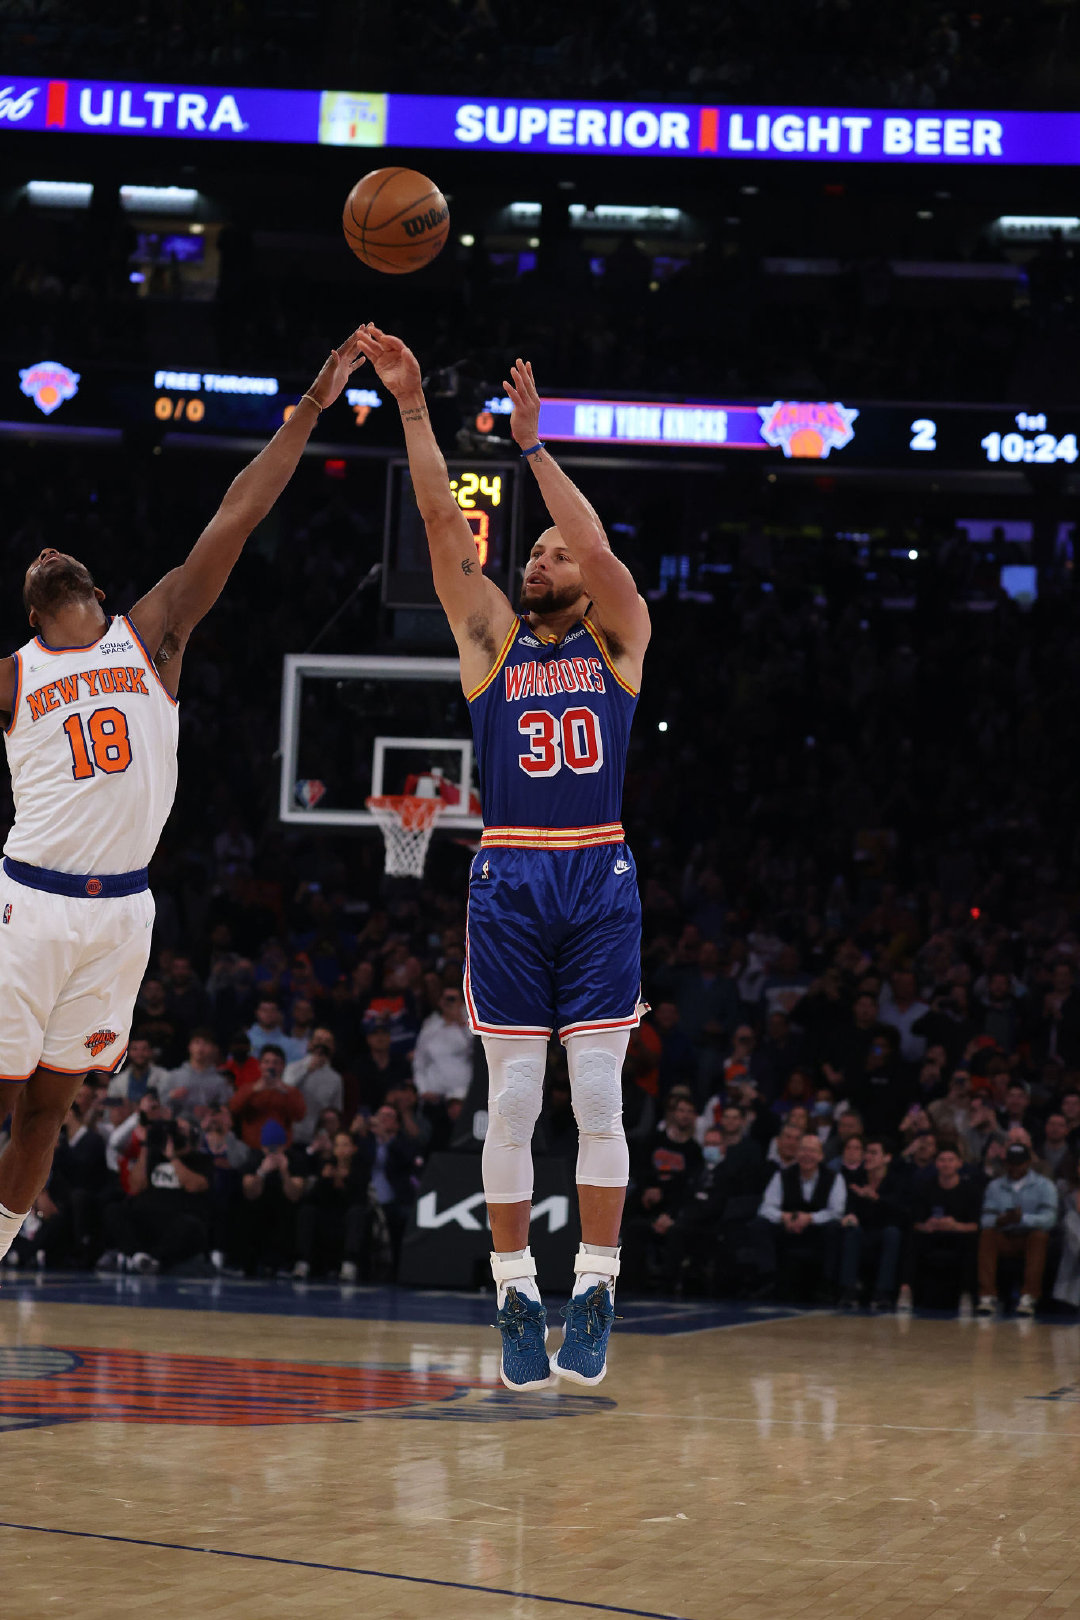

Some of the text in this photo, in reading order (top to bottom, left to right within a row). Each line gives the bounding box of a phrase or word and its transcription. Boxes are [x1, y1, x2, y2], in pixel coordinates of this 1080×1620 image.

[79, 88, 243, 132] ULTRA
[454, 104, 690, 149] SUPERIOR
[728, 113, 1003, 156] LIGHT BEER
[155, 371, 279, 396] FREE THROWS
[353, 405, 371, 427] 7
[574, 404, 728, 443] NEW YORK KNICKS
[1015, 412, 1047, 431] 1st
[910, 419, 937, 450] 2
[981, 432, 1079, 463] 10:24
[100, 640, 131, 650] SQUARE
[101, 647, 127, 656] SPACE
[26, 667, 149, 722] NEW YORK
[63, 706, 133, 781] 18
[517, 706, 604, 778] 30
